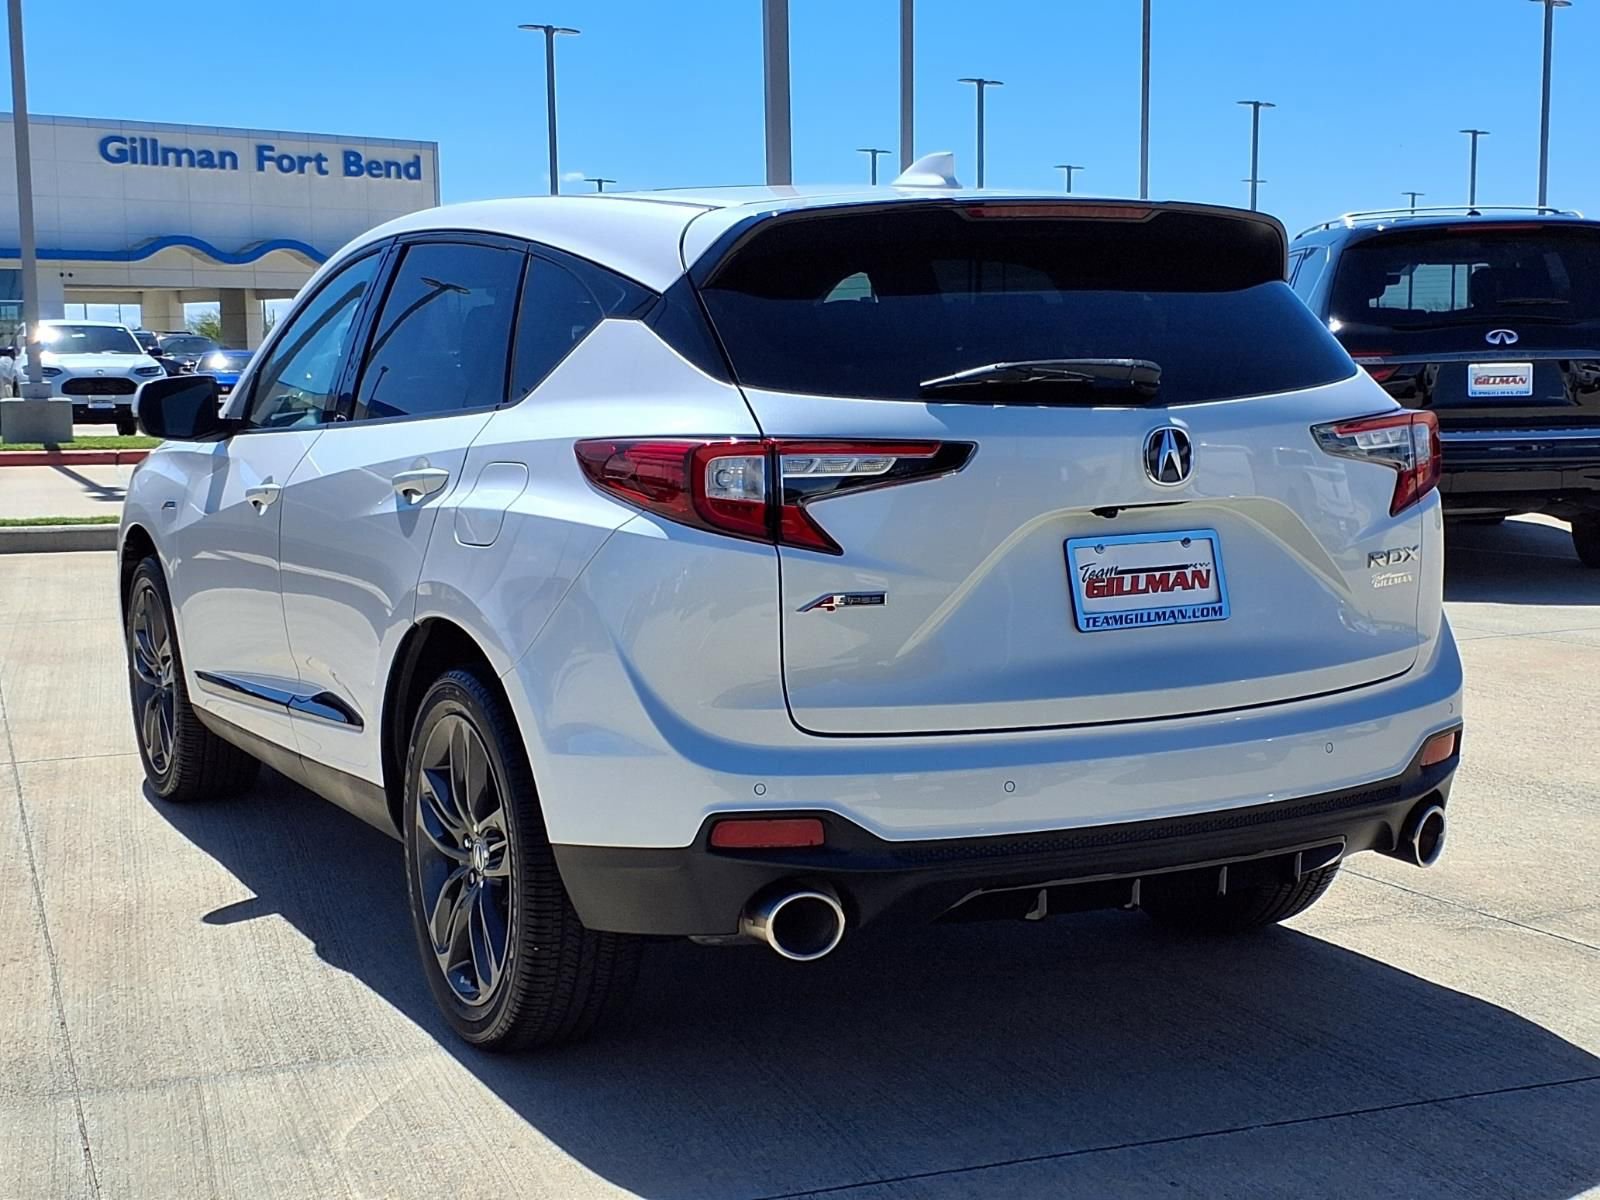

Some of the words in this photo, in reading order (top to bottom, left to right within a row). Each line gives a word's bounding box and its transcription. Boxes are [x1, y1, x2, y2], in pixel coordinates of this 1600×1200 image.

[99, 135, 239, 171] Gillman
[256, 144, 329, 175] Fort
[343, 149, 422, 181] Bend
[1367, 544, 1419, 569] RDX
[1079, 562, 1119, 583] Team
[1085, 568, 1212, 599] GILLMAN
[1084, 605, 1223, 629] TEAMGILLMAN.COM
